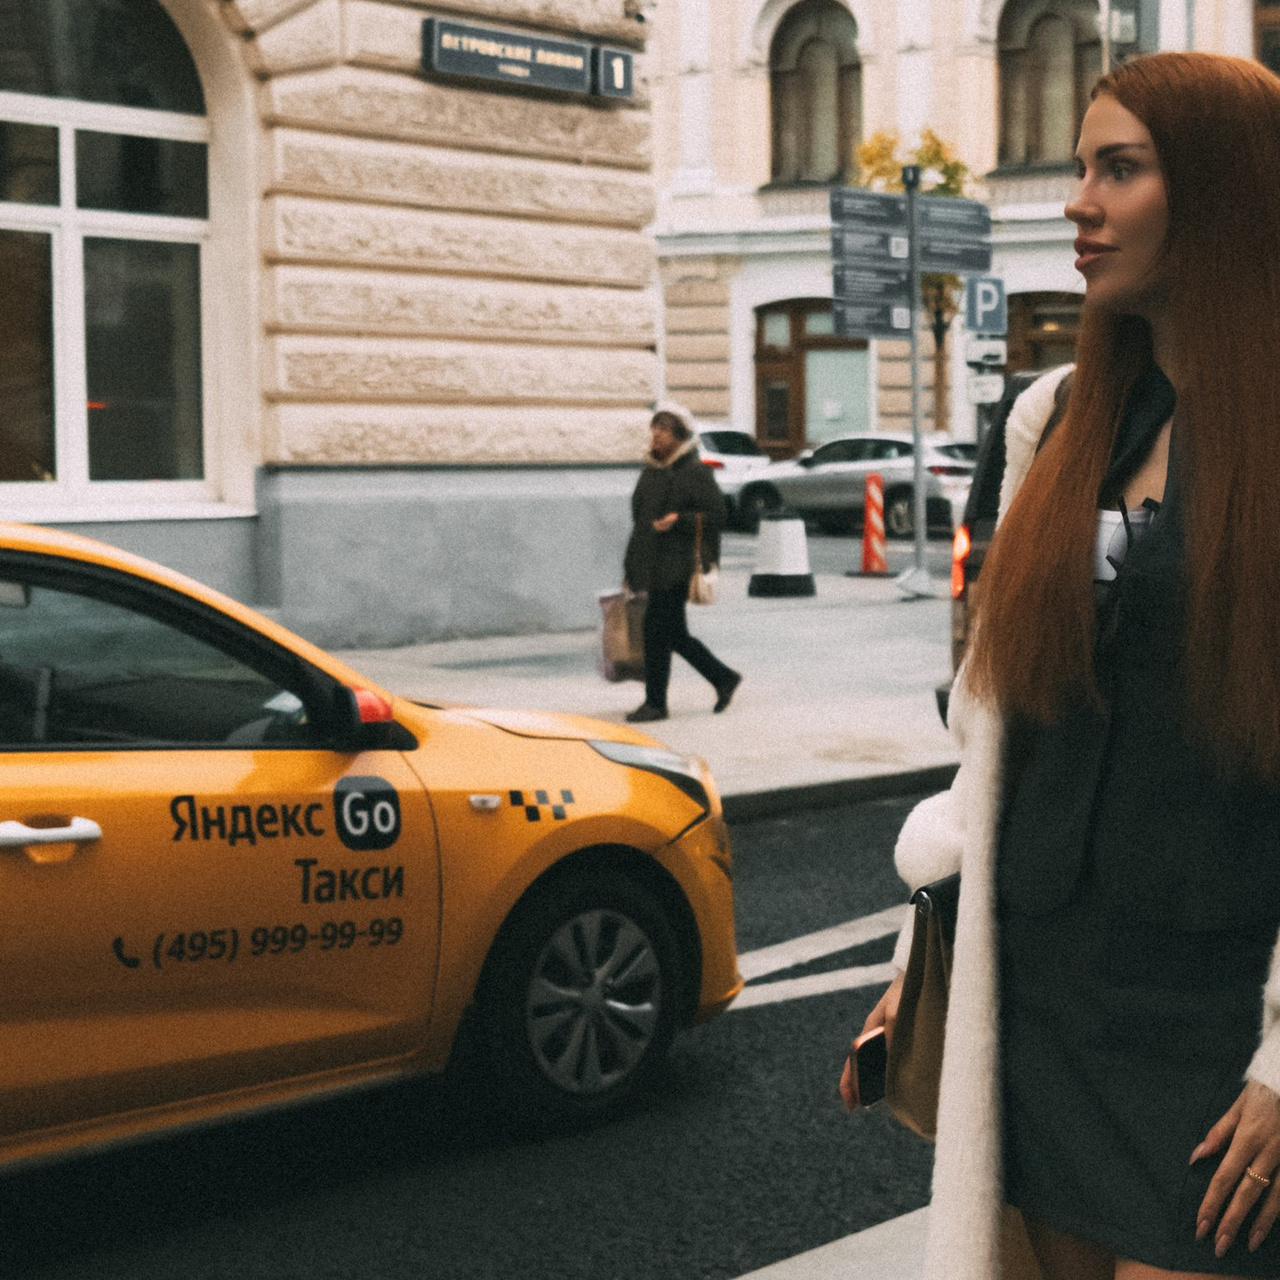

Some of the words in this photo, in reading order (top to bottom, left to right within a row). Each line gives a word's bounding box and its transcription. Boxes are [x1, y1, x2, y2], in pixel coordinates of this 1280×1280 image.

[612, 57, 625, 90] 1
[170, 795, 325, 847] Яндекс
[343, 791, 396, 836] Go
[294, 858, 404, 904] Такси
[152, 928, 239, 970] (495)
[250, 917, 404, 956] 999-99-99
